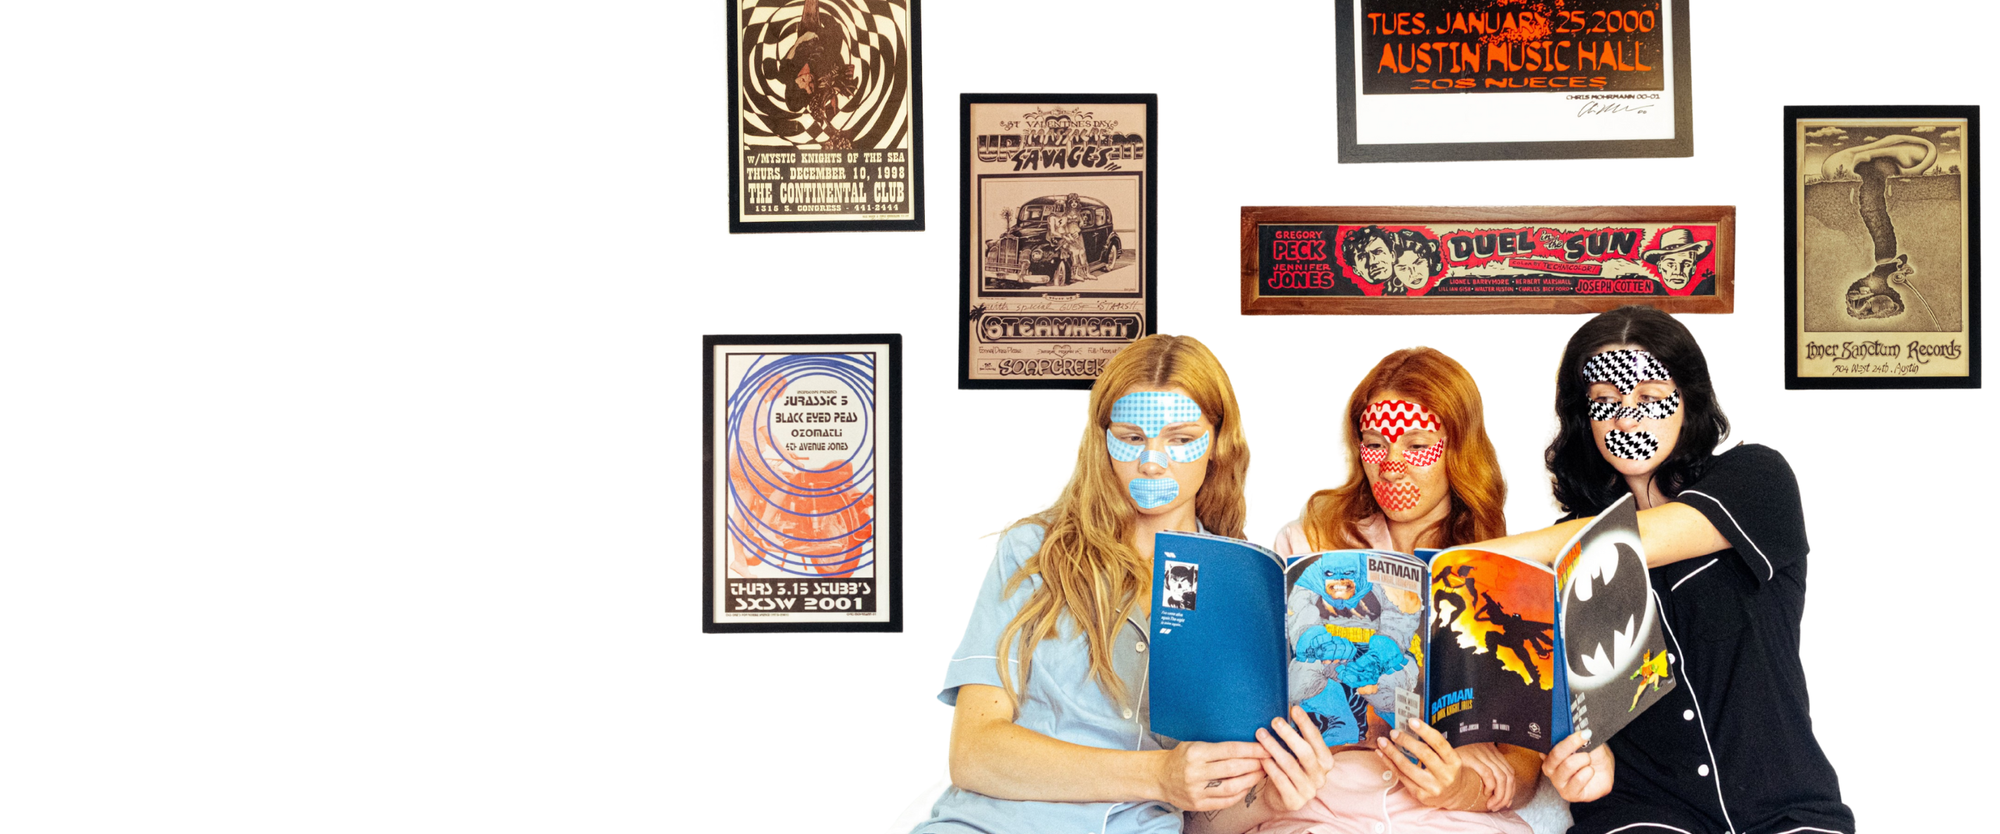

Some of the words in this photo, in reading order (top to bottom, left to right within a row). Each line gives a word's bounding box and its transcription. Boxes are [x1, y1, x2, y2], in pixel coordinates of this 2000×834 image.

[1367, 12, 1430, 35] TUES.
[1436, 11, 1551, 35] JANUARY
[1377, 42, 1480, 73] AUSTIN
[1486, 41, 1571, 72] MUSIC
[1577, 41, 1652, 71] HALL
[1484, 76, 1607, 90] NUECES
[801, 152, 842, 163] KNIGHTS
[847, 152, 859, 163] OF
[864, 152, 882, 163] THE
[887, 151, 905, 163] SEA
[1012, 146, 1114, 172] SAVAGES
[746, 167, 784, 181] THURS.
[790, 167, 846, 181] DECEMBER
[853, 166, 870, 182] 10,
[877, 166, 905, 180] 1998
[748, 183, 773, 204] THE
[780, 181, 867, 204] CONTINENTAL
[873, 181, 905, 203] CLUB
[1275, 231, 1323, 240] GREGORY
[1273, 240, 1327, 261] PECK
[1448, 231, 1536, 263] DUEL
[1563, 231, 1637, 263] SUN
[1273, 263, 1331, 271] JENNIFER
[1268, 271, 1335, 289] JONES
[1577, 280, 1612, 292] JOSEPH
[1614, 280, 1652, 292] COTTEN
[985, 317, 1134, 340] STEAMHEAT
[1833, 340, 1900, 362] Sanctum
[1907, 339, 1962, 363] Records
[784, 396, 837, 406] JURASSIC
[775, 413, 804, 423] BLACK
[806, 413, 831, 423] EYED
[834, 412, 858, 422] PEAS
[791, 429, 842, 437] OZOMATLI
[827, 442, 848, 450] JONES
[1369, 559, 1419, 582] BATMAN
[777, 583, 808, 595] 3.15
[813, 583, 871, 595] STUBB'S
[735, 598, 797, 610] SXSW
[804, 597, 862, 610] 2001
[1432, 687, 1473, 715] BATMAN
